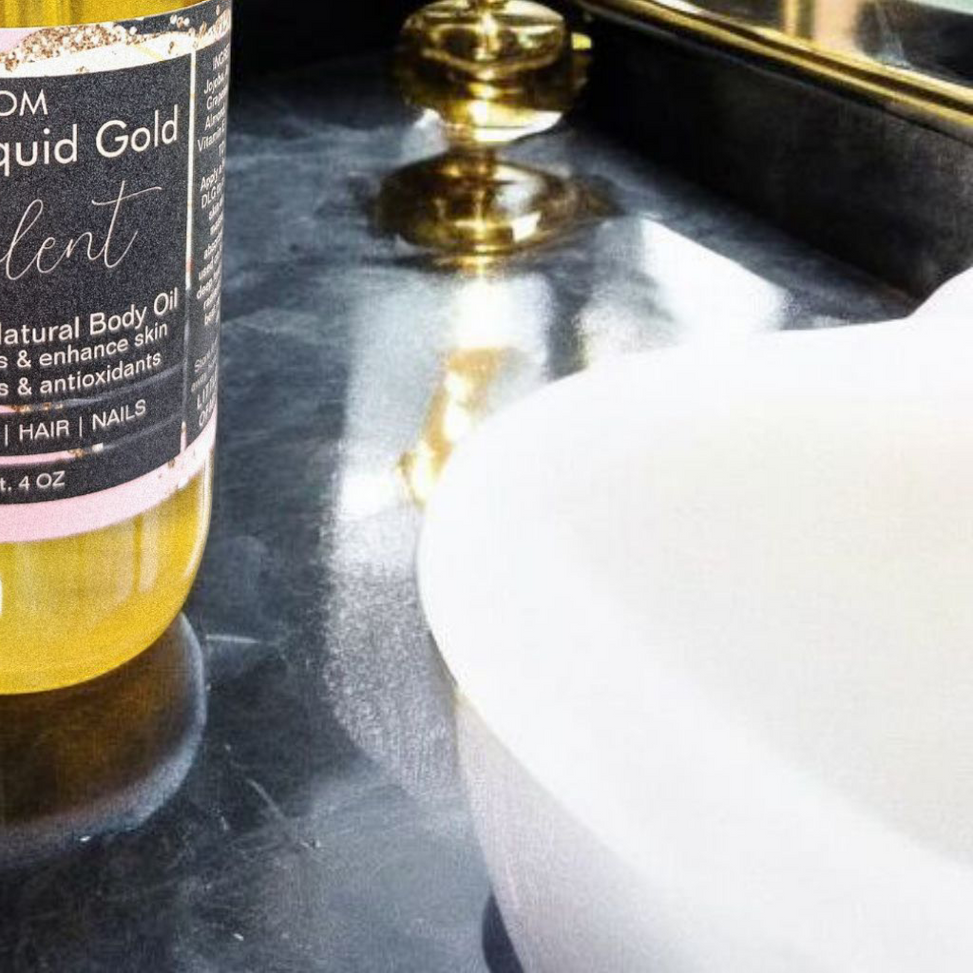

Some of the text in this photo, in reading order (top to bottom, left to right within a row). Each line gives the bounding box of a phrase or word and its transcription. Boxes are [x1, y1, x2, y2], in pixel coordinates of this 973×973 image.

[96, 105, 179, 159] Gold
[201, 186, 216, 209] DLG
[89, 303, 147, 337] Body
[154, 287, 178, 317] Oil
[17, 350, 32, 368] &
[40, 337, 128, 367] enhance
[134, 322, 168, 349] skin
[17, 377, 32, 395] &
[40, 352, 161, 395] antioxidants
[19, 419, 69, 442] HAIR
[92, 400, 147, 430] NAILS
[19, 475, 30, 491] 4
[36, 472, 66, 488] OZ
